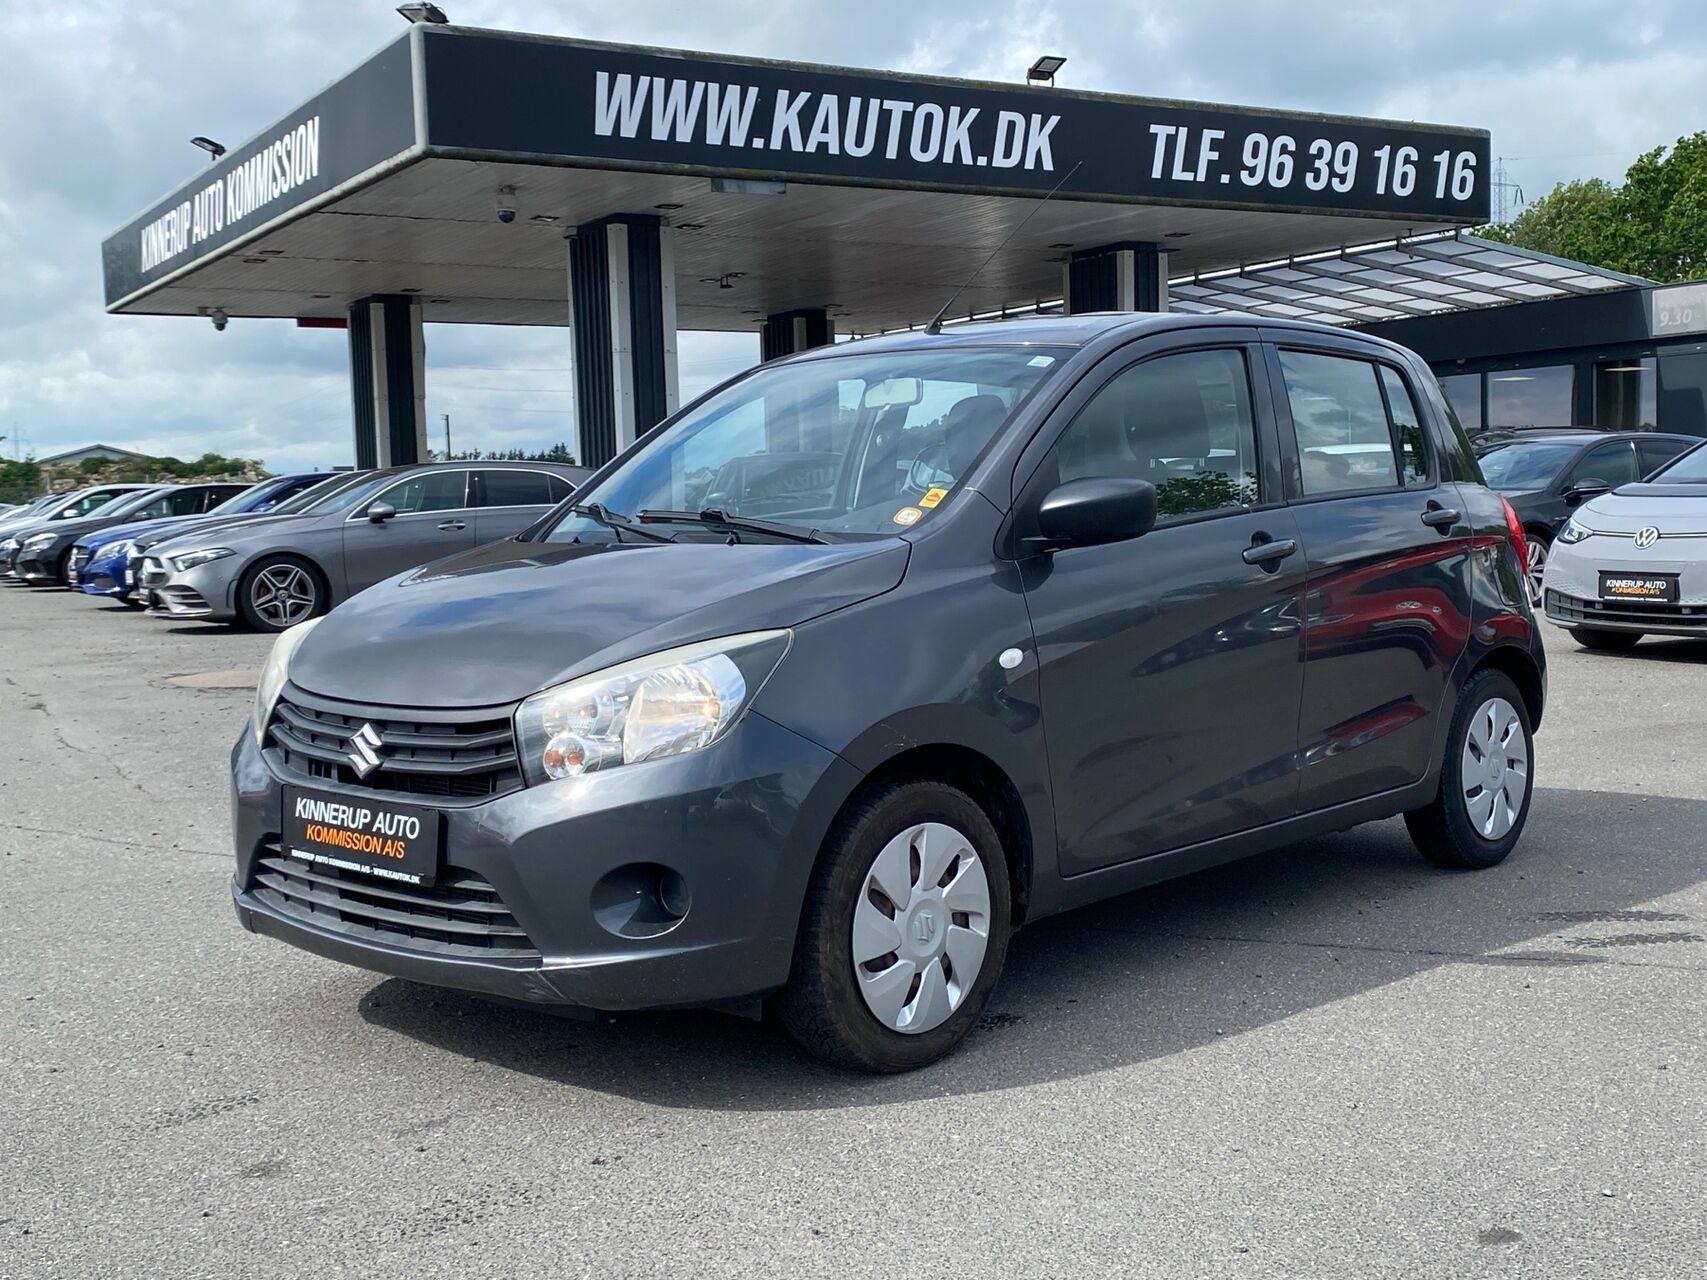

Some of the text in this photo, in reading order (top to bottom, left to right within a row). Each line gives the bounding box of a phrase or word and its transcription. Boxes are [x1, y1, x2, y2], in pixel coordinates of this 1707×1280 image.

[594, 71, 1061, 171] WWW.KAUTOK.DK
[1149, 124, 1477, 201] TLF. 96 39 16 16
[140, 116, 320, 273] KINNERUP AUTO KOMMISSION
[1644, 581, 1667, 590] AUTO
[295, 797, 421, 840] KINNERUP AUTO
[306, 824, 406, 860] KOMMISSION A/S
